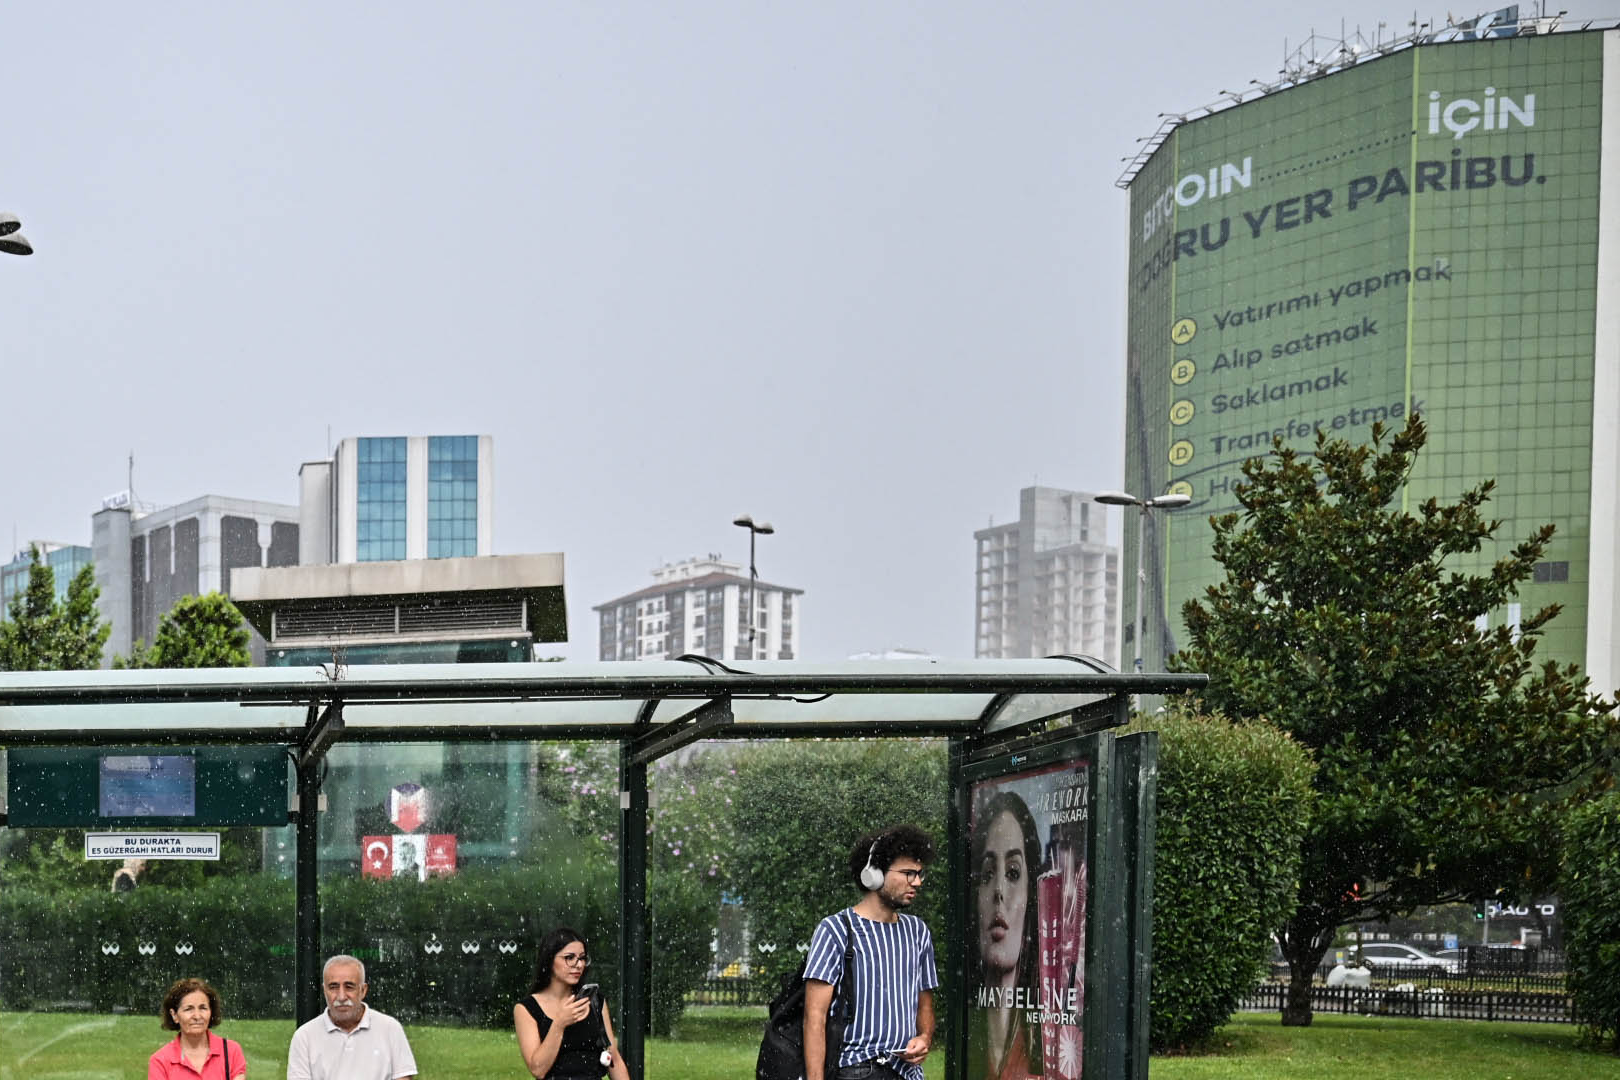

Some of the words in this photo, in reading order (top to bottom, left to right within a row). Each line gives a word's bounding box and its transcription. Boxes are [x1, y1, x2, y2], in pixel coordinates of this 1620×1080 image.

[1429, 87, 1536, 140] İÇİN
[1243, 188, 1333, 239] YER
[1347, 149, 1547, 212] PARİBU.
[1178, 324, 1190, 336] A
[1213, 292, 1321, 331] Yatırımı
[1330, 258, 1452, 306] yapmak
[1177, 366, 1188, 378] B
[1211, 348, 1262, 374] Alıp
[1271, 316, 1378, 360] satmak
[1176, 407, 1187, 419] C
[1211, 367, 1349, 415] Saklamak
[1176, 447, 1187, 458] D
[1210, 416, 1323, 456] Transfer
[1331, 395, 1426, 432] etmek
[1051, 807, 1088, 825] MASKARA
[104, 846, 149, 854] GÜZERGAHI
[186, 847, 213, 855] DURUR
[1026, 1012, 1047, 1023] NEW
[1048, 1013, 1077, 1025] YORK
